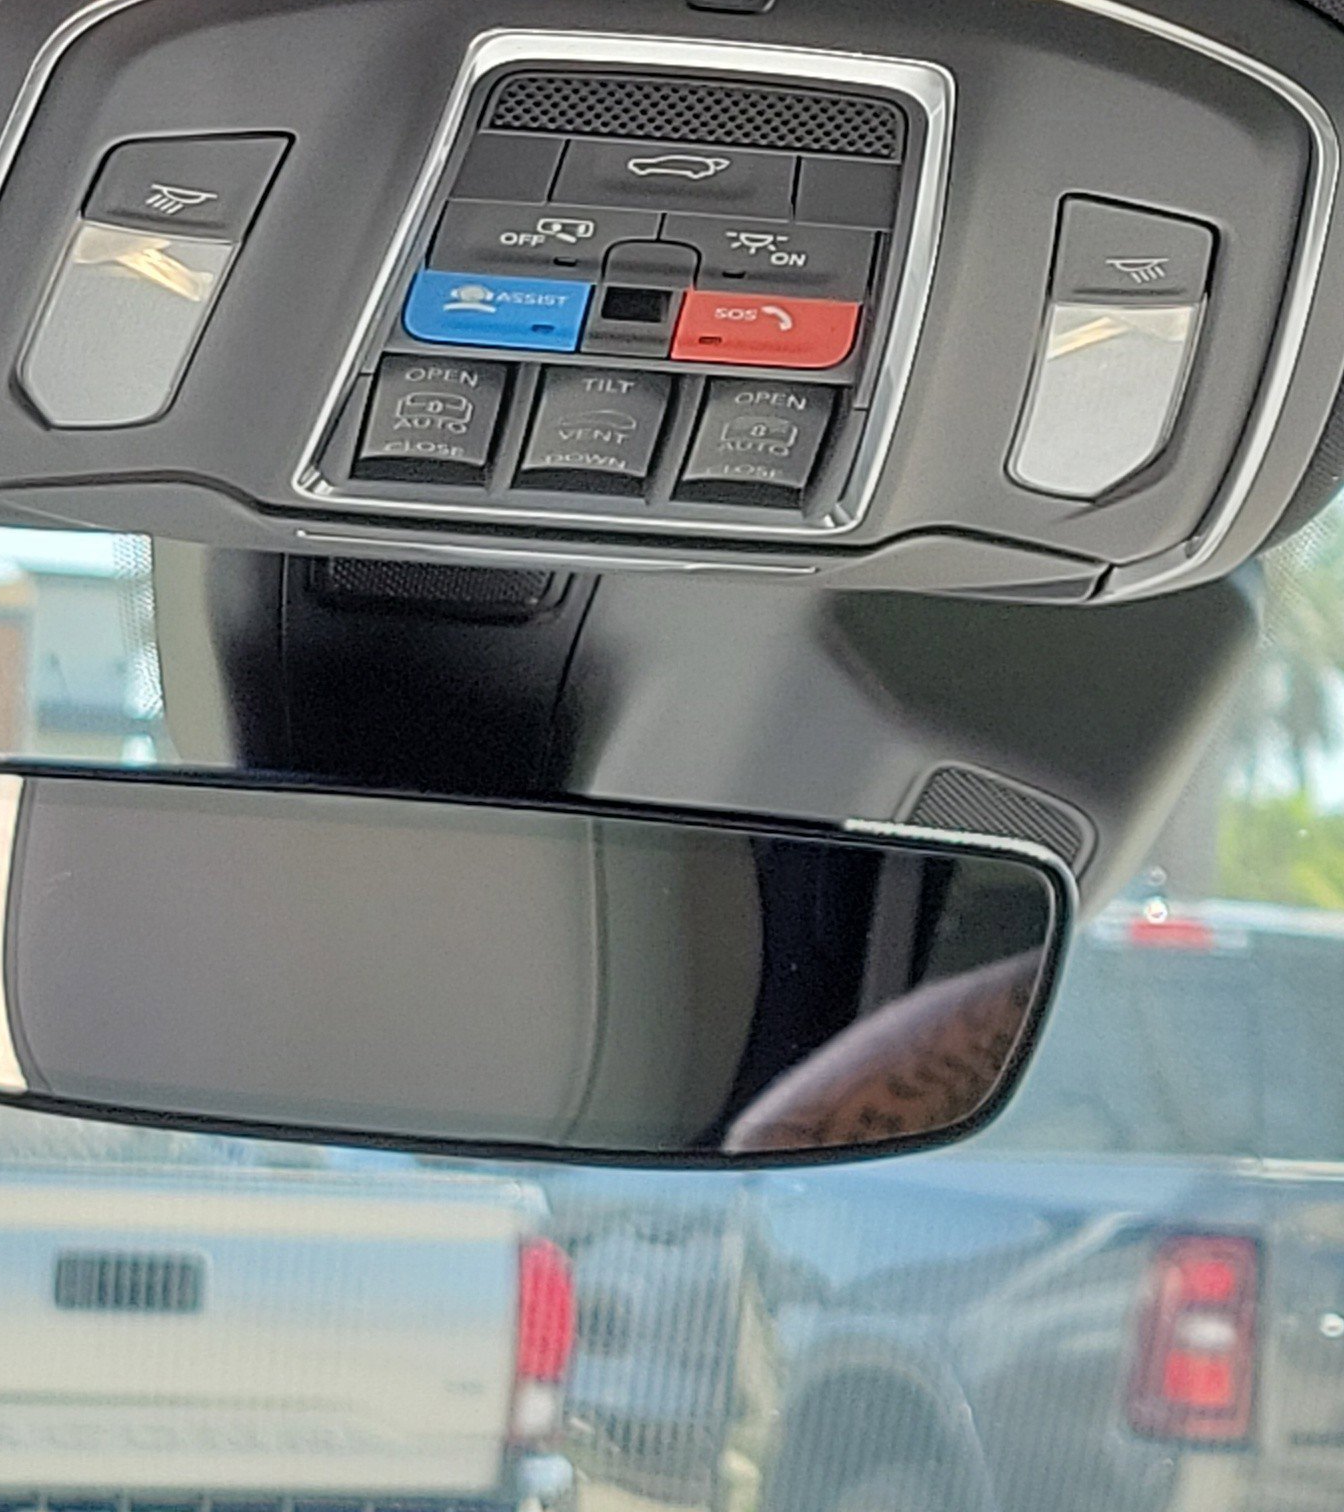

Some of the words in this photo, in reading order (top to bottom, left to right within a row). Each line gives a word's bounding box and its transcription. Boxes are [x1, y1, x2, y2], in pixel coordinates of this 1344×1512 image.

[500, 232, 546, 247] OFF
[770, 252, 806, 267] ON
[496, 291, 569, 307] ASSIST
[715, 307, 758, 321] SOS
[405, 367, 479, 387] OPEN
[582, 378, 635, 394] TILT
[734, 391, 806, 410] OPEN
[393, 416, 468, 434] AUTO
[558, 428, 630, 445] VENT
[718, 440, 790, 457] AUTO
[544, 453, 627, 470] DOWN
[705, 464, 784, 479] LOSE
